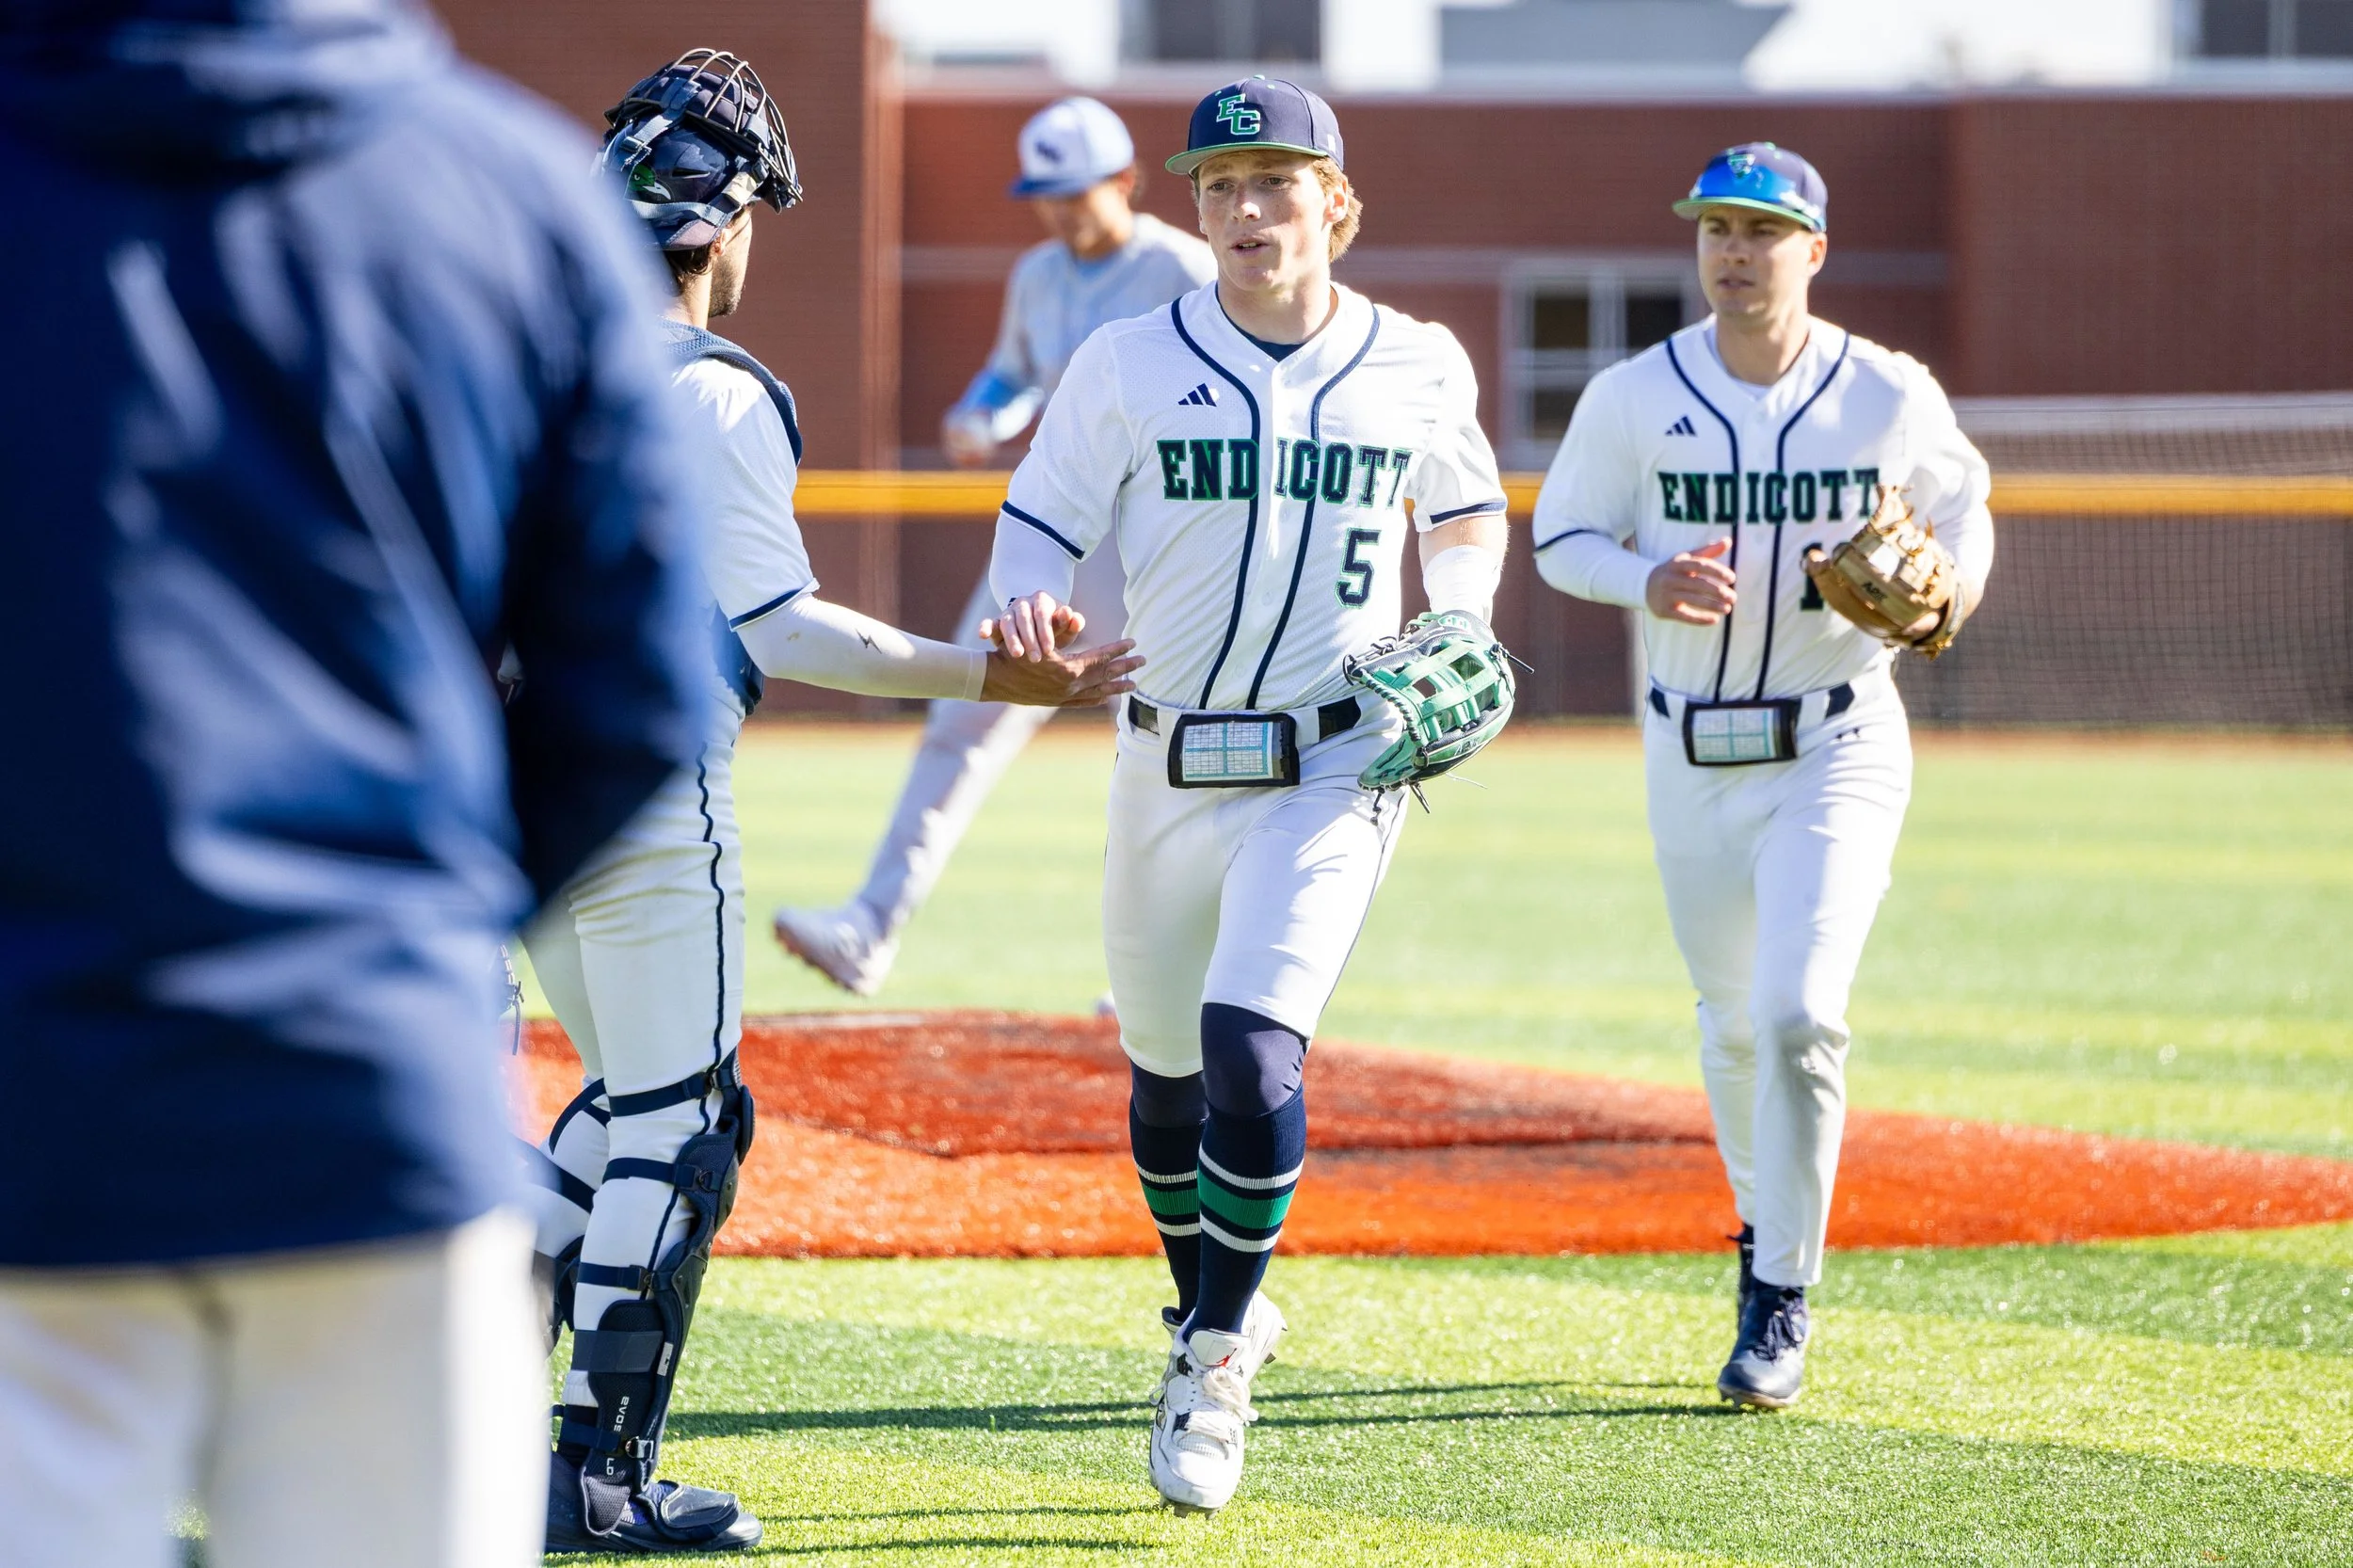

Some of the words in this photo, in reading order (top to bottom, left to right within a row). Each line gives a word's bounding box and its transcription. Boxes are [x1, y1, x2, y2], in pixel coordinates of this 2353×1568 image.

[1216, 92, 1262, 136] EC
[1157, 438, 1414, 510] ENDICOTT
[1657, 467, 1880, 524] ENDICOTT
[1335, 527, 1382, 609] 5
